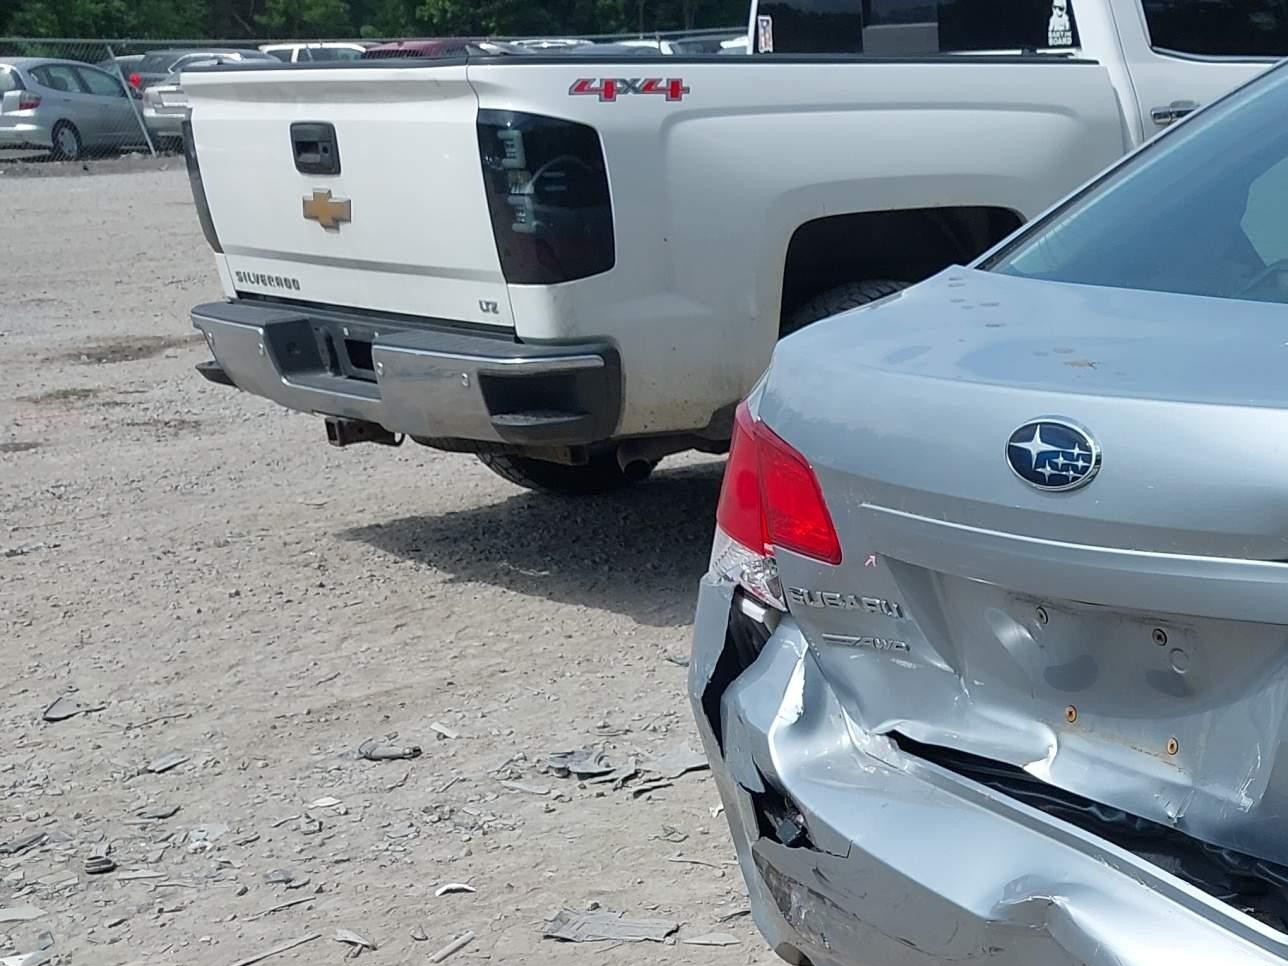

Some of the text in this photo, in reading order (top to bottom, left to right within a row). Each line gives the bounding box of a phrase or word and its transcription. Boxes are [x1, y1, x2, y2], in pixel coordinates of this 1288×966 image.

[235, 271, 301, 291] SILVERADO
[478, 299, 499, 314] LTZ
[788, 585, 904, 619] SUBARU
